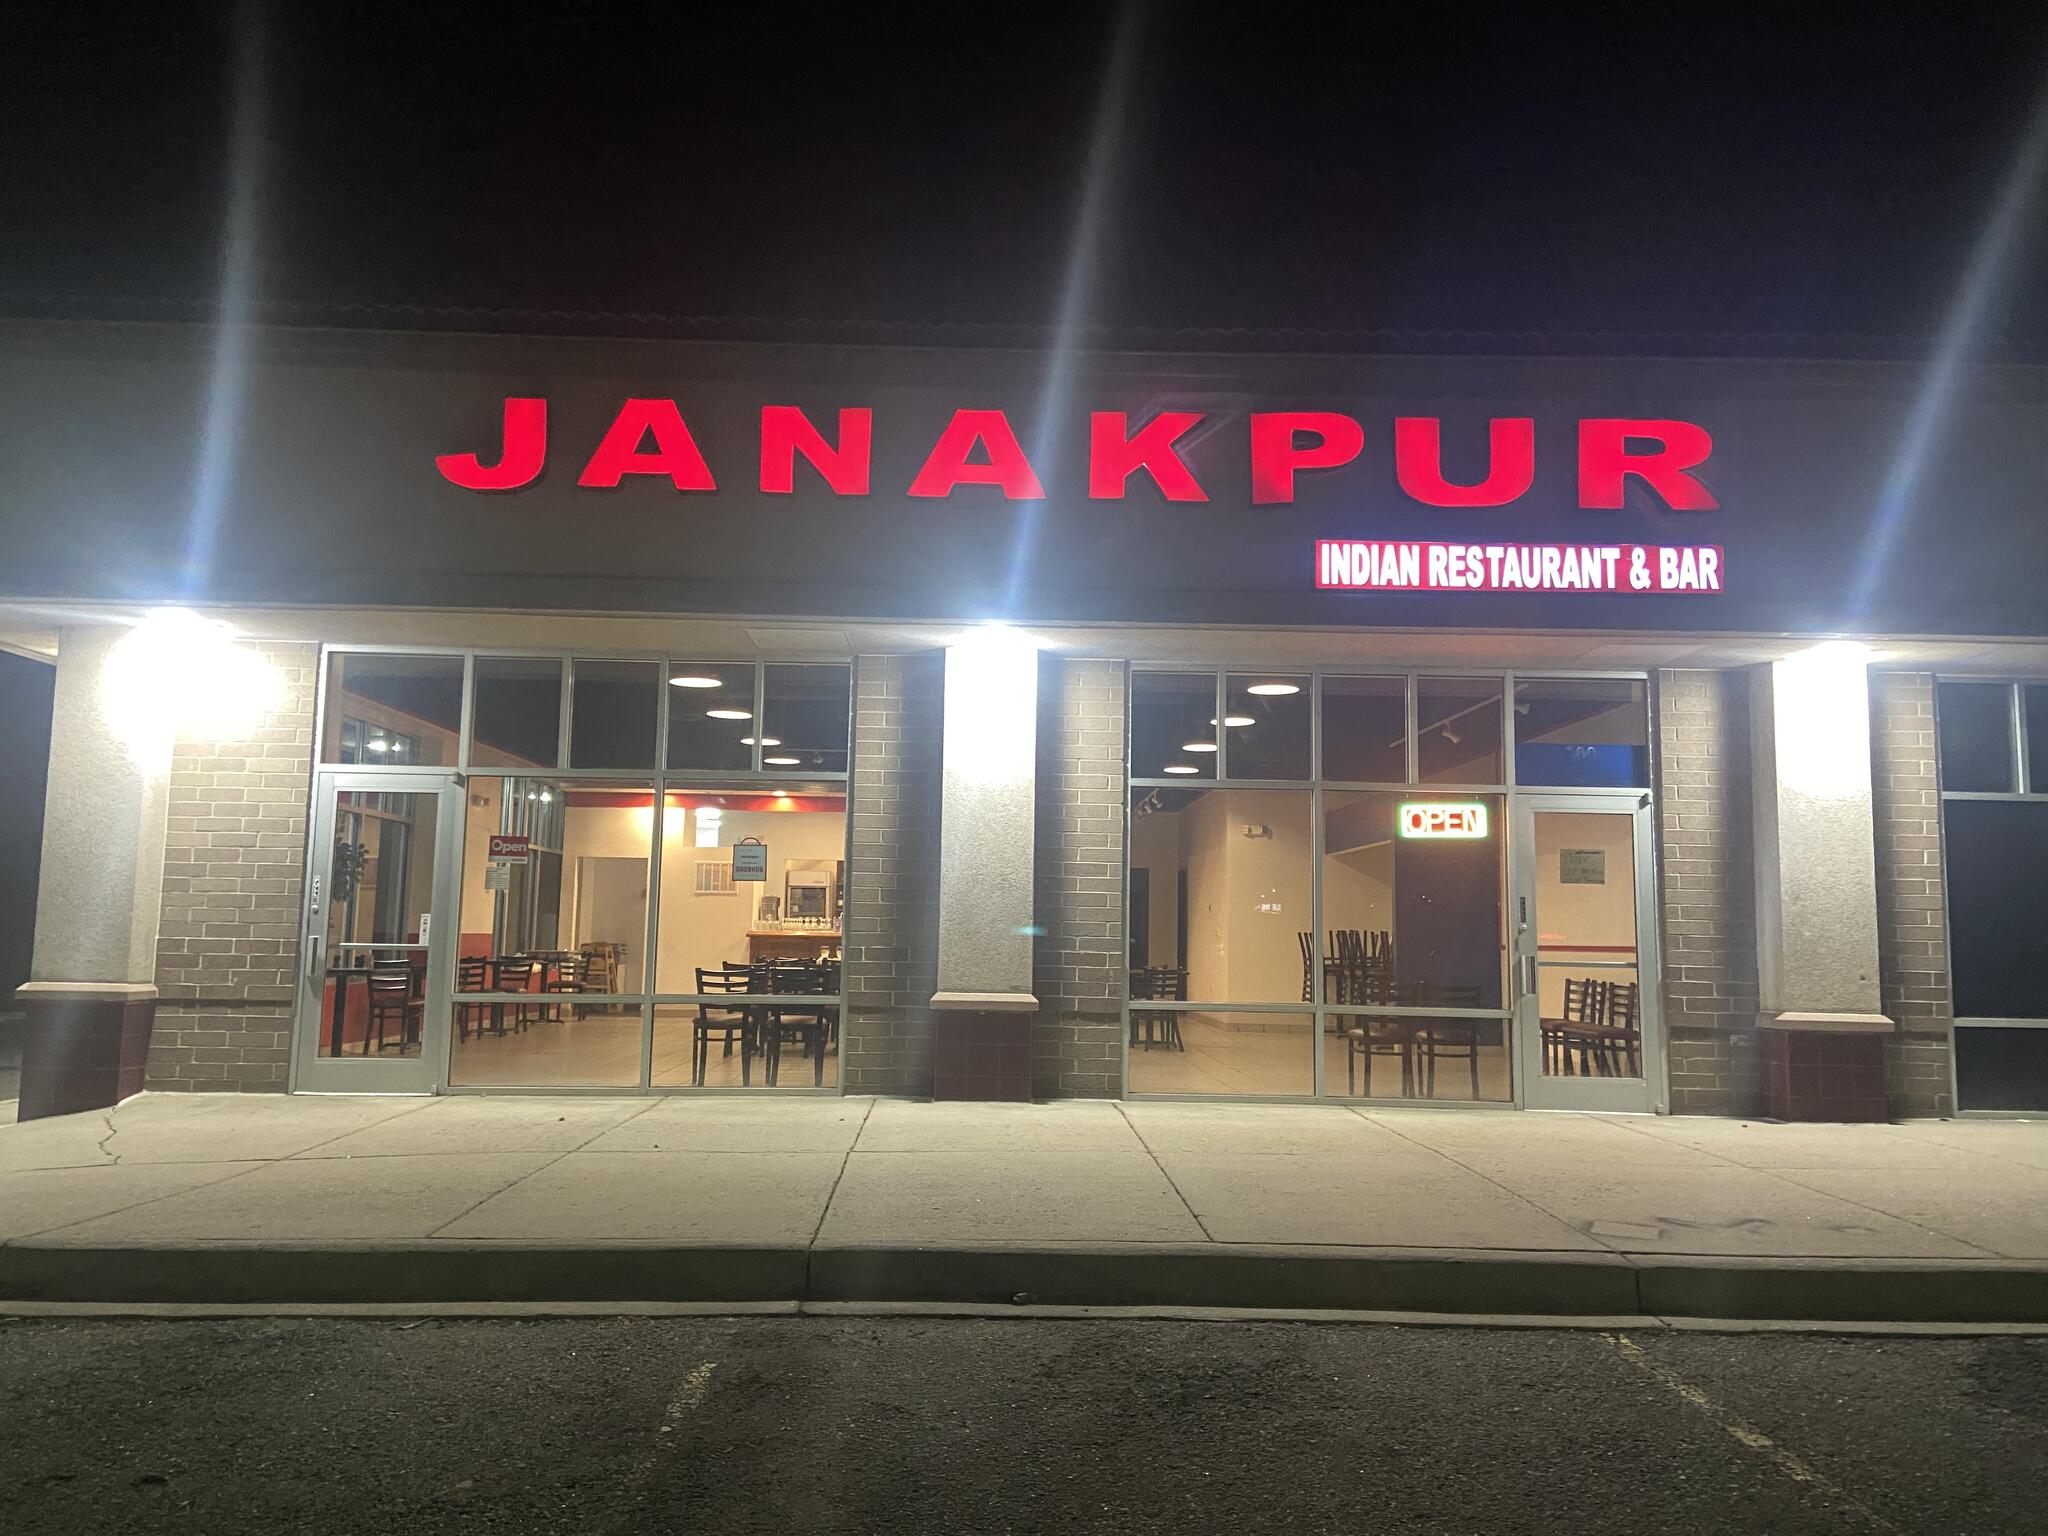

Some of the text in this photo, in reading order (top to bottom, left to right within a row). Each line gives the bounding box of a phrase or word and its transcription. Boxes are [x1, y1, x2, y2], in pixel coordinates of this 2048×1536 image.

[435, 397, 1718, 511] JANAKPUR
[1321, 543, 1720, 590] INDIAN RESTAURANT & BAR
[1405, 807, 1481, 834] OPEN
[491, 839, 527, 854] Open
